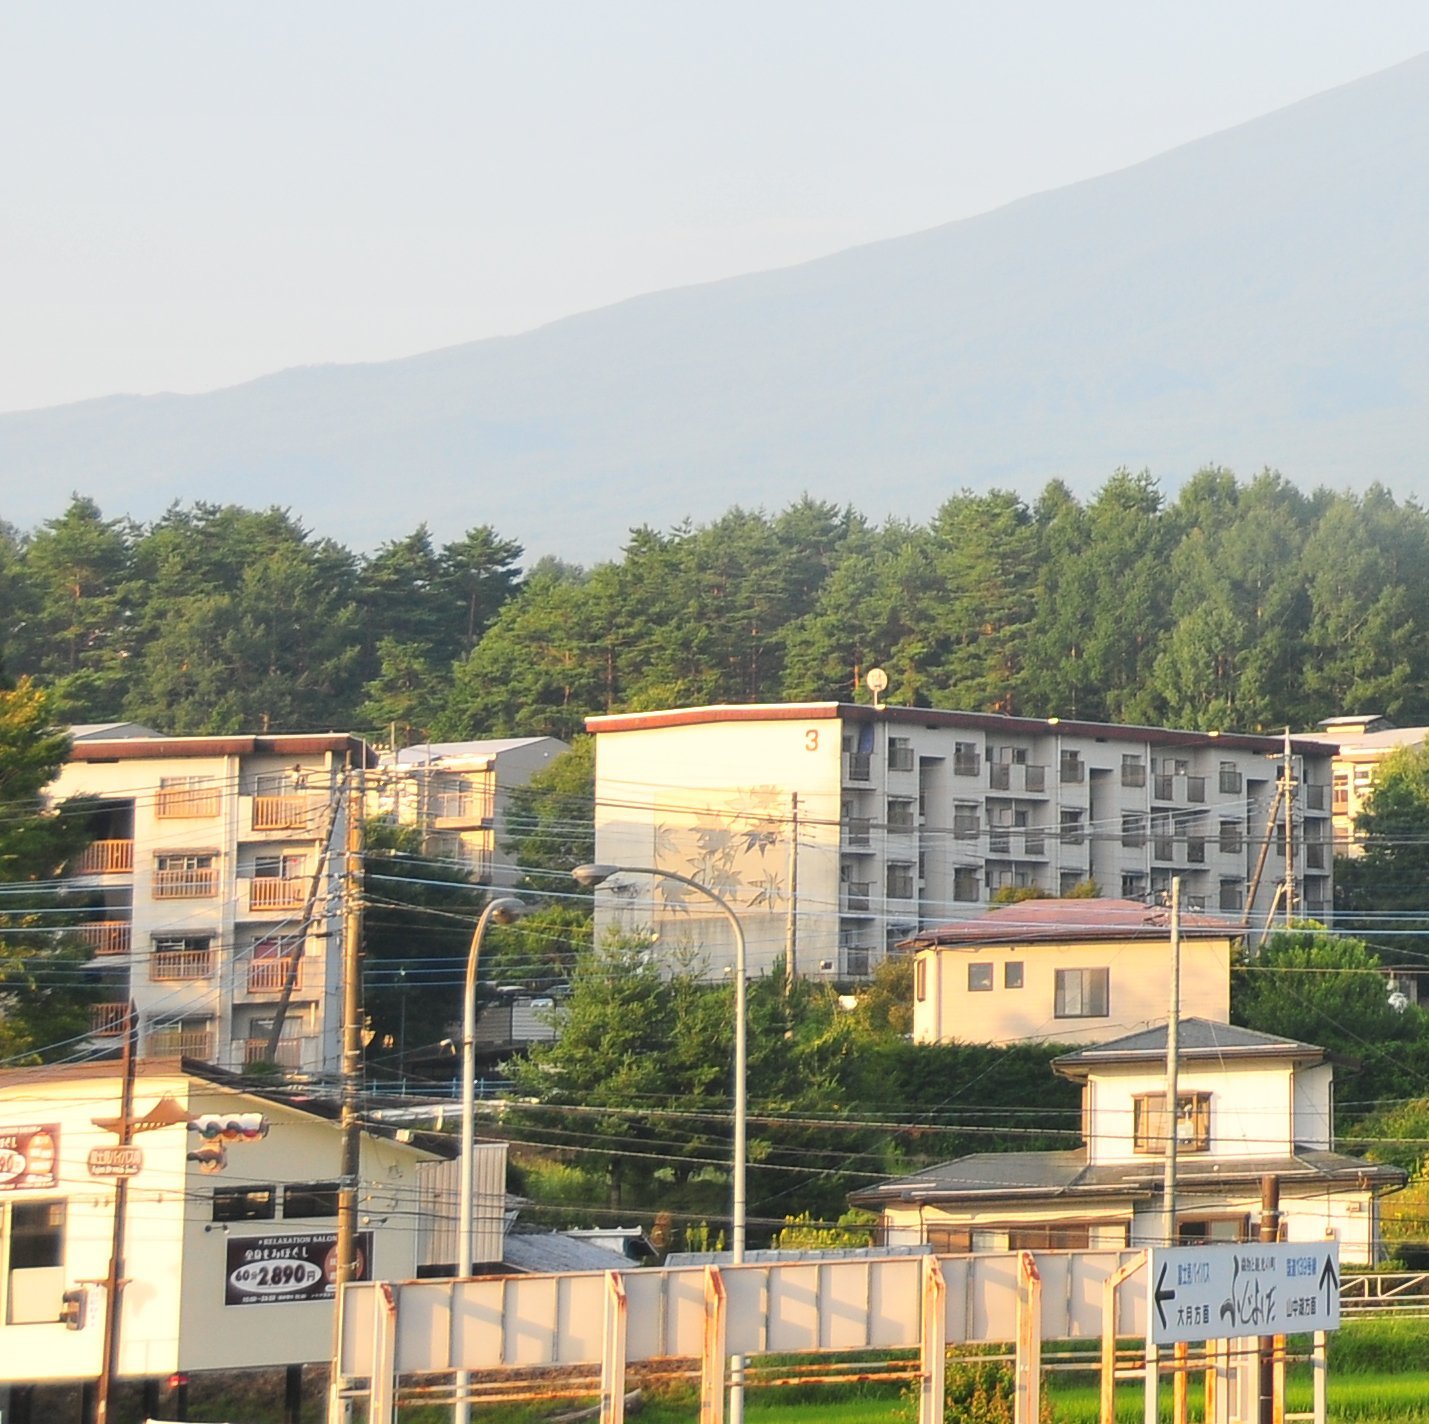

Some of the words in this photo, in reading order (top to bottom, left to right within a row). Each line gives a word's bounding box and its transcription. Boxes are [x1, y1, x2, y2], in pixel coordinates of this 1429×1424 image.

[806, 729, 819, 752] 3
[1177, 1304, 1210, 1327] 大月方面
